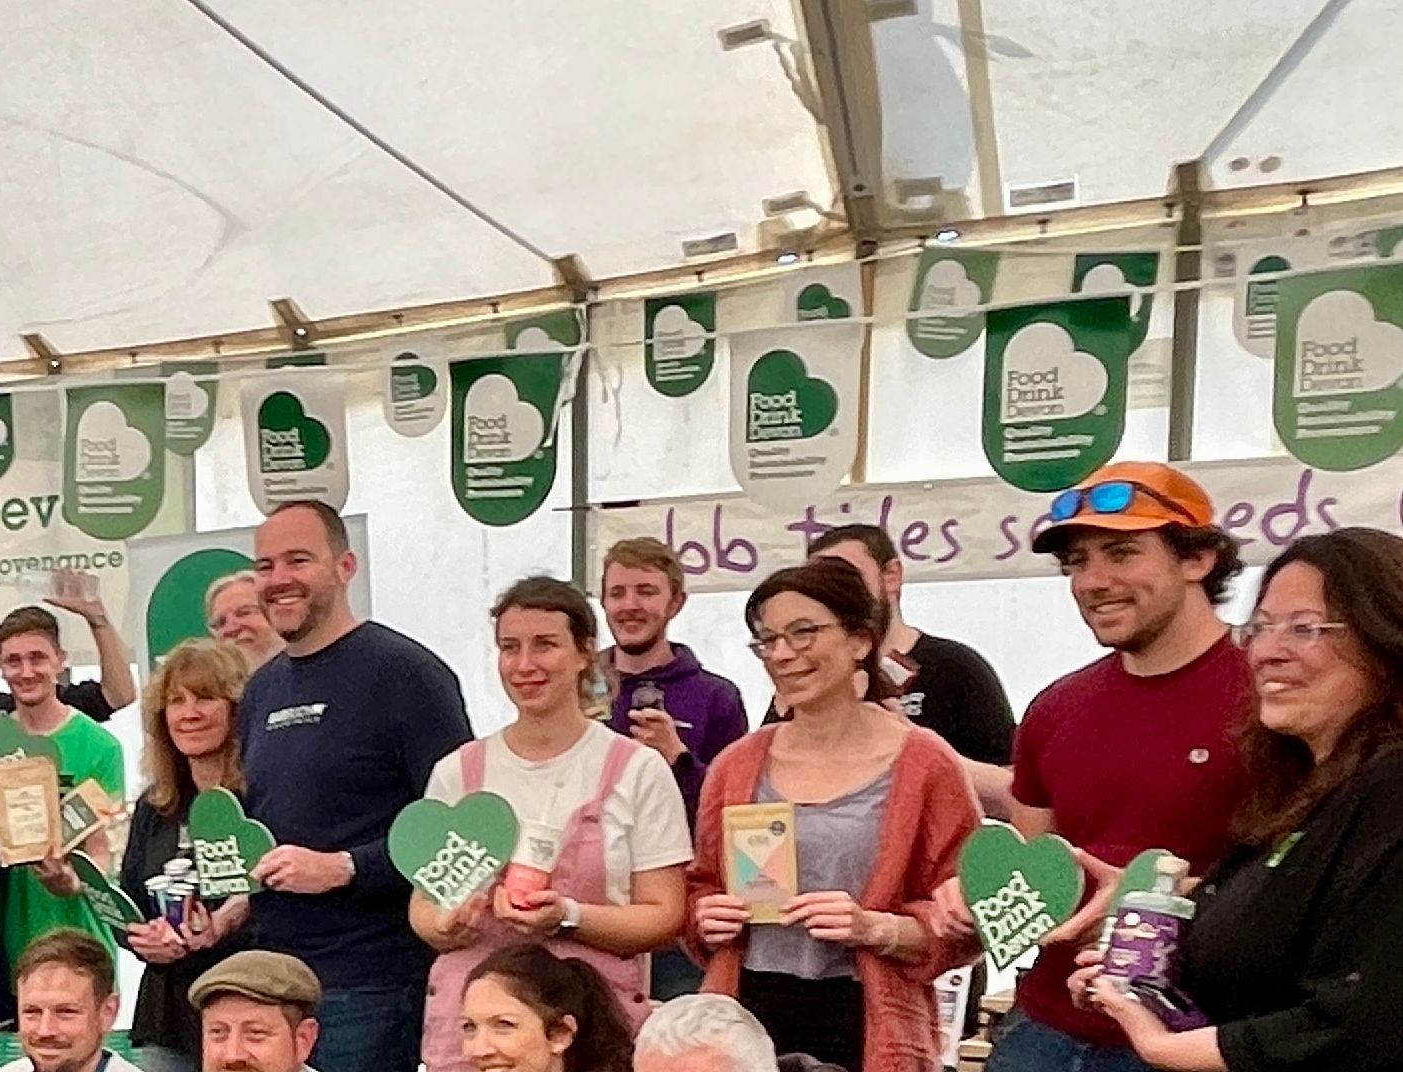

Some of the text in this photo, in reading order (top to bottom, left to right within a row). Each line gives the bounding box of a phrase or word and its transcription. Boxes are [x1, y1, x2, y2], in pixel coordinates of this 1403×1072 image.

[1007, 367, 1059, 387] Food
[1007, 385, 1064, 403] Drink
[194, 835, 240, 860] Food
[197, 856, 247, 878] Drink
[412, 831, 466, 889] Food
[429, 840, 488, 906] Drink
[972, 870, 1030, 926] Food
[982, 890, 1047, 947] Drink
[991, 912, 1056, 968] Devon
